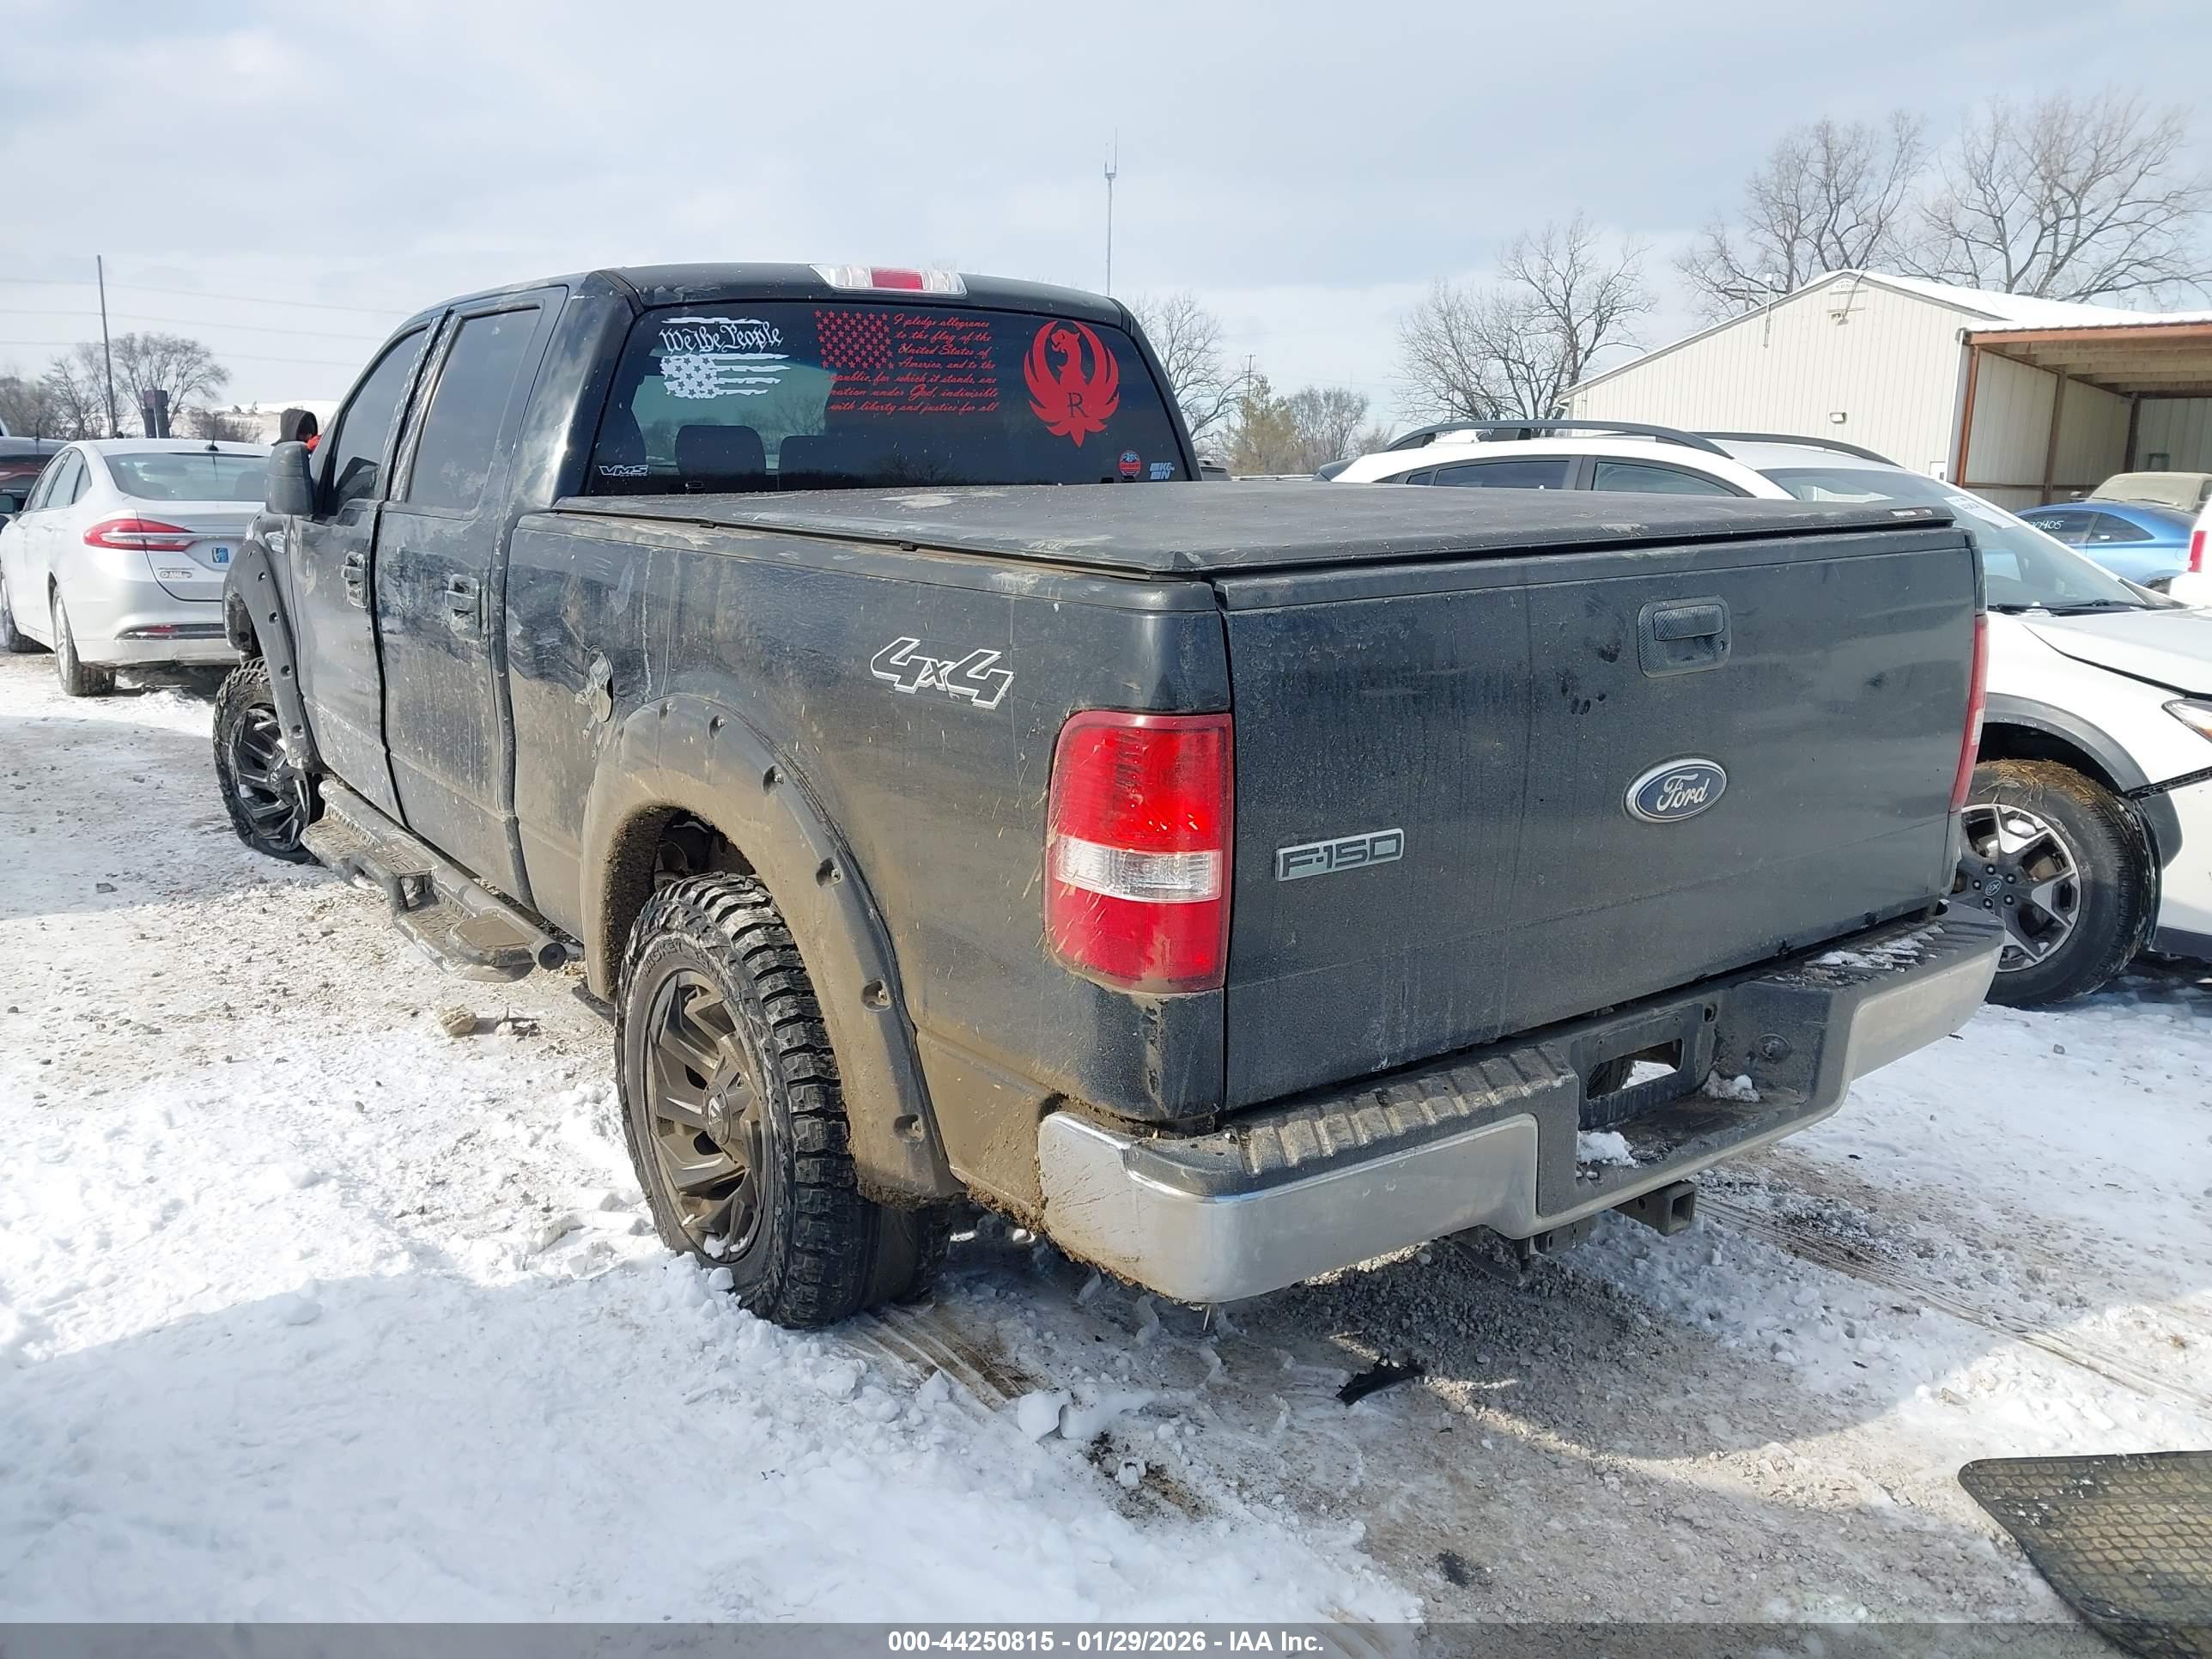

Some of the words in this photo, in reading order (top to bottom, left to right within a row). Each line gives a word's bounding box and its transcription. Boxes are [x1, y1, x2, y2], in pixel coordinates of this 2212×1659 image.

[903, 316, 936, 329] pledge
[659, 328, 696, 355] We
[682, 326, 725, 353] the
[720, 321, 783, 353] People
[909, 330, 928, 338] the
[930, 330, 956, 343] flag
[958, 331, 975, 344] of
[975, 331, 992, 341] the
[898, 343, 939, 355] United
[939, 343, 974, 356] States
[977, 346, 992, 359] of
[946, 359, 968, 368] and
[981, 360, 996, 369] the
[872, 371, 890, 386] for
[894, 372, 927, 383] which
[927, 374, 940, 383] it
[871, 386, 904, 396] under
[830, 400, 856, 410] with
[857, 401, 896, 415] liberty
[896, 401, 924, 410] and
[920, 403, 958, 416] justice
[959, 402, 975, 416] for
[978, 402, 1000, 411] all
[1068, 392, 1089, 419] R
[599, 465, 648, 476] VMS
[870, 636, 1015, 710] 4x4
[1656, 773, 1711, 813] Ford
[1283, 829, 1404, 878] F-150
